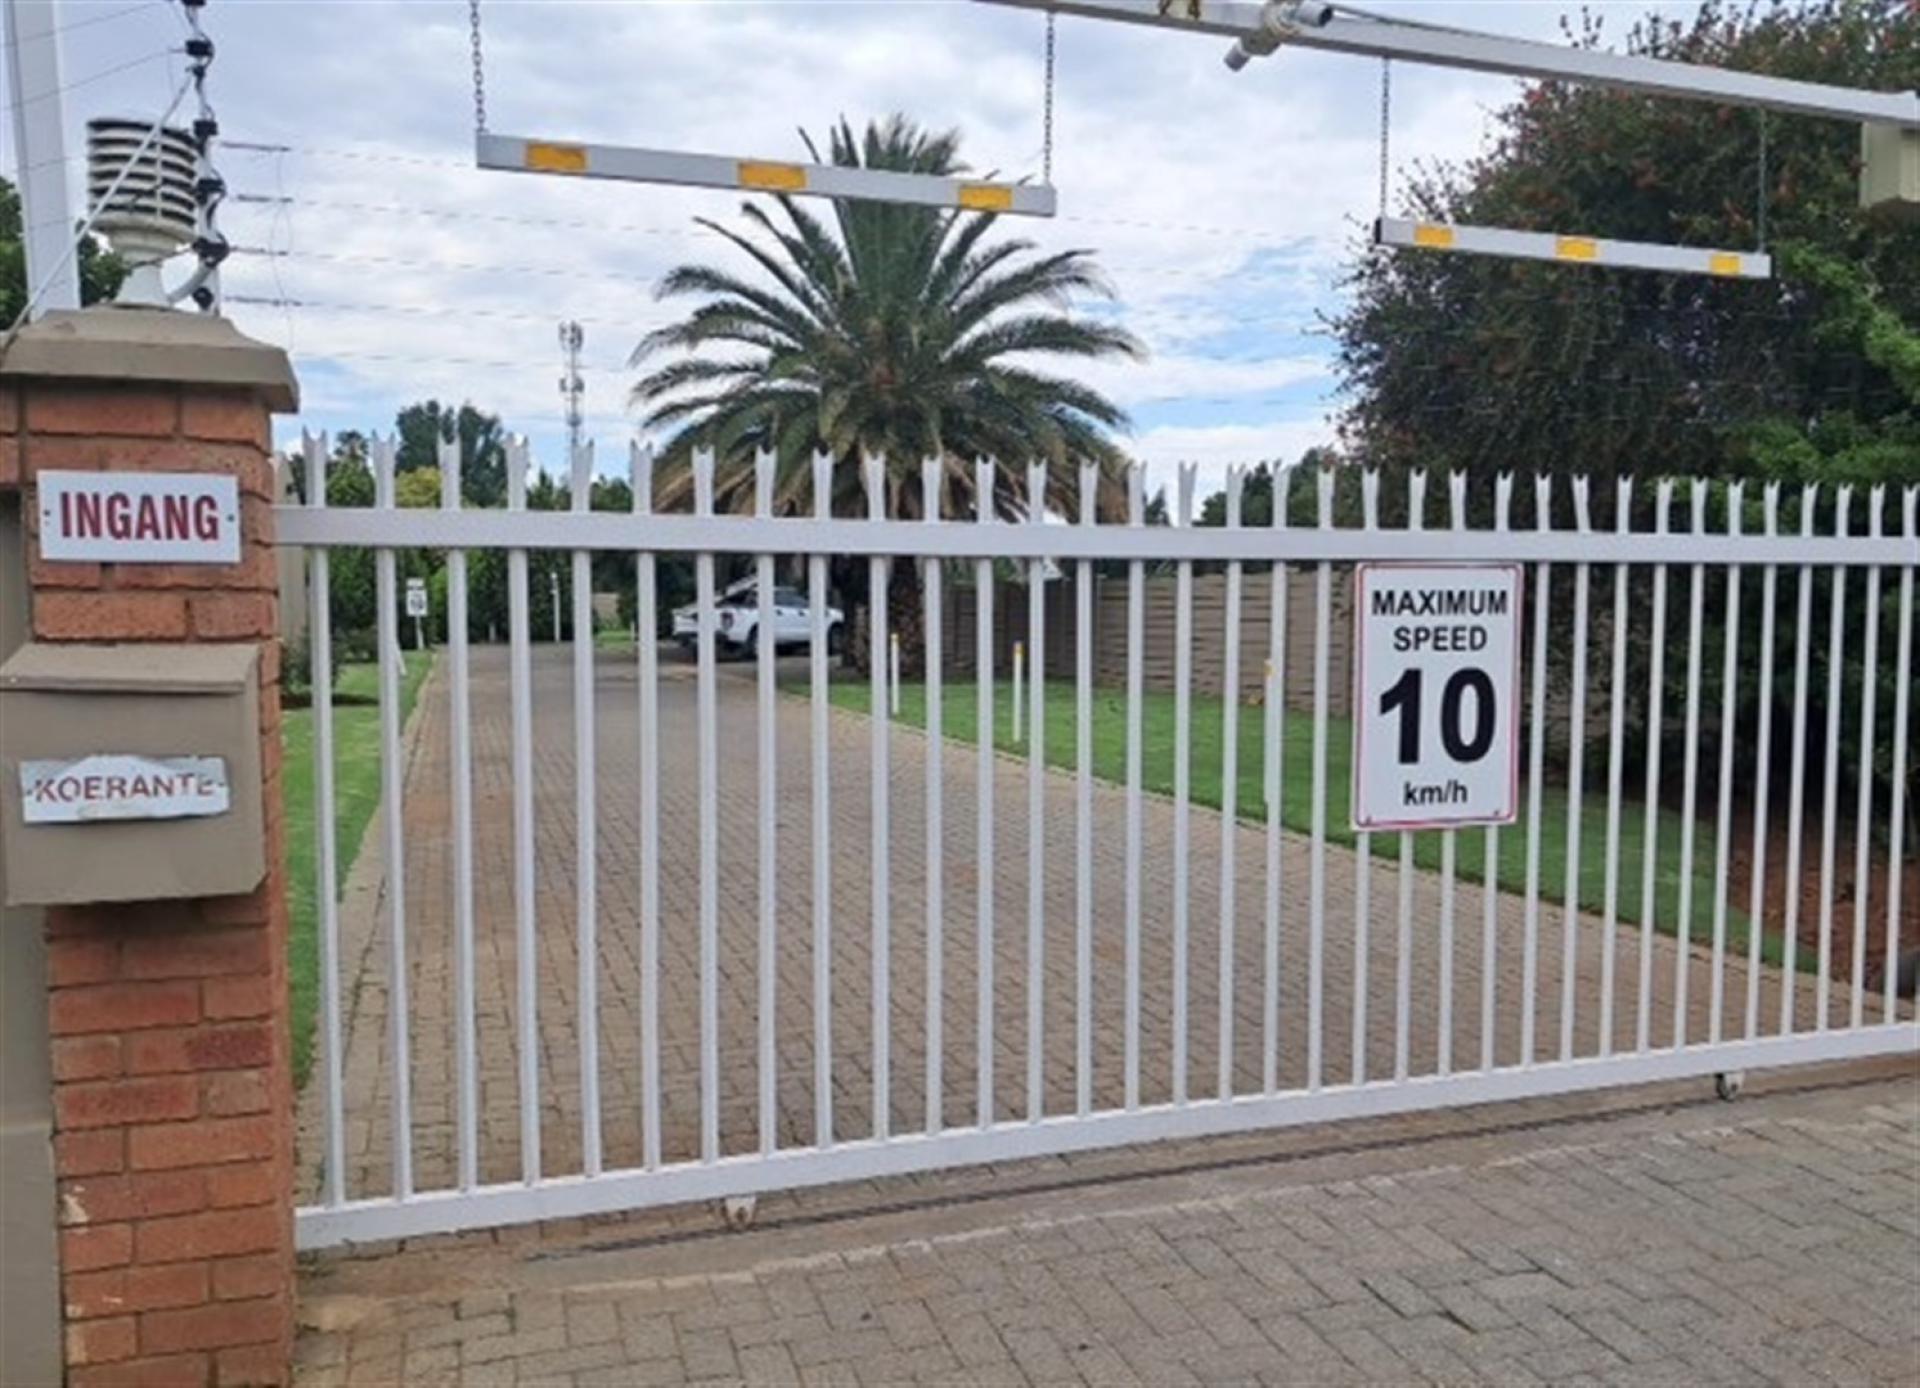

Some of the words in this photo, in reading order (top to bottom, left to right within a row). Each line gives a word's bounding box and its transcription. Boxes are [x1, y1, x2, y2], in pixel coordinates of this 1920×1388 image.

[60, 491, 219, 541] INGANG
[1372, 590, 1508, 616] MAXIMUM
[1393, 626, 1488, 652] SPEED
[1379, 667, 1497, 765] 10
[34, 773, 215, 802] KOERANTE
[1403, 780, 1468, 806] km/h
